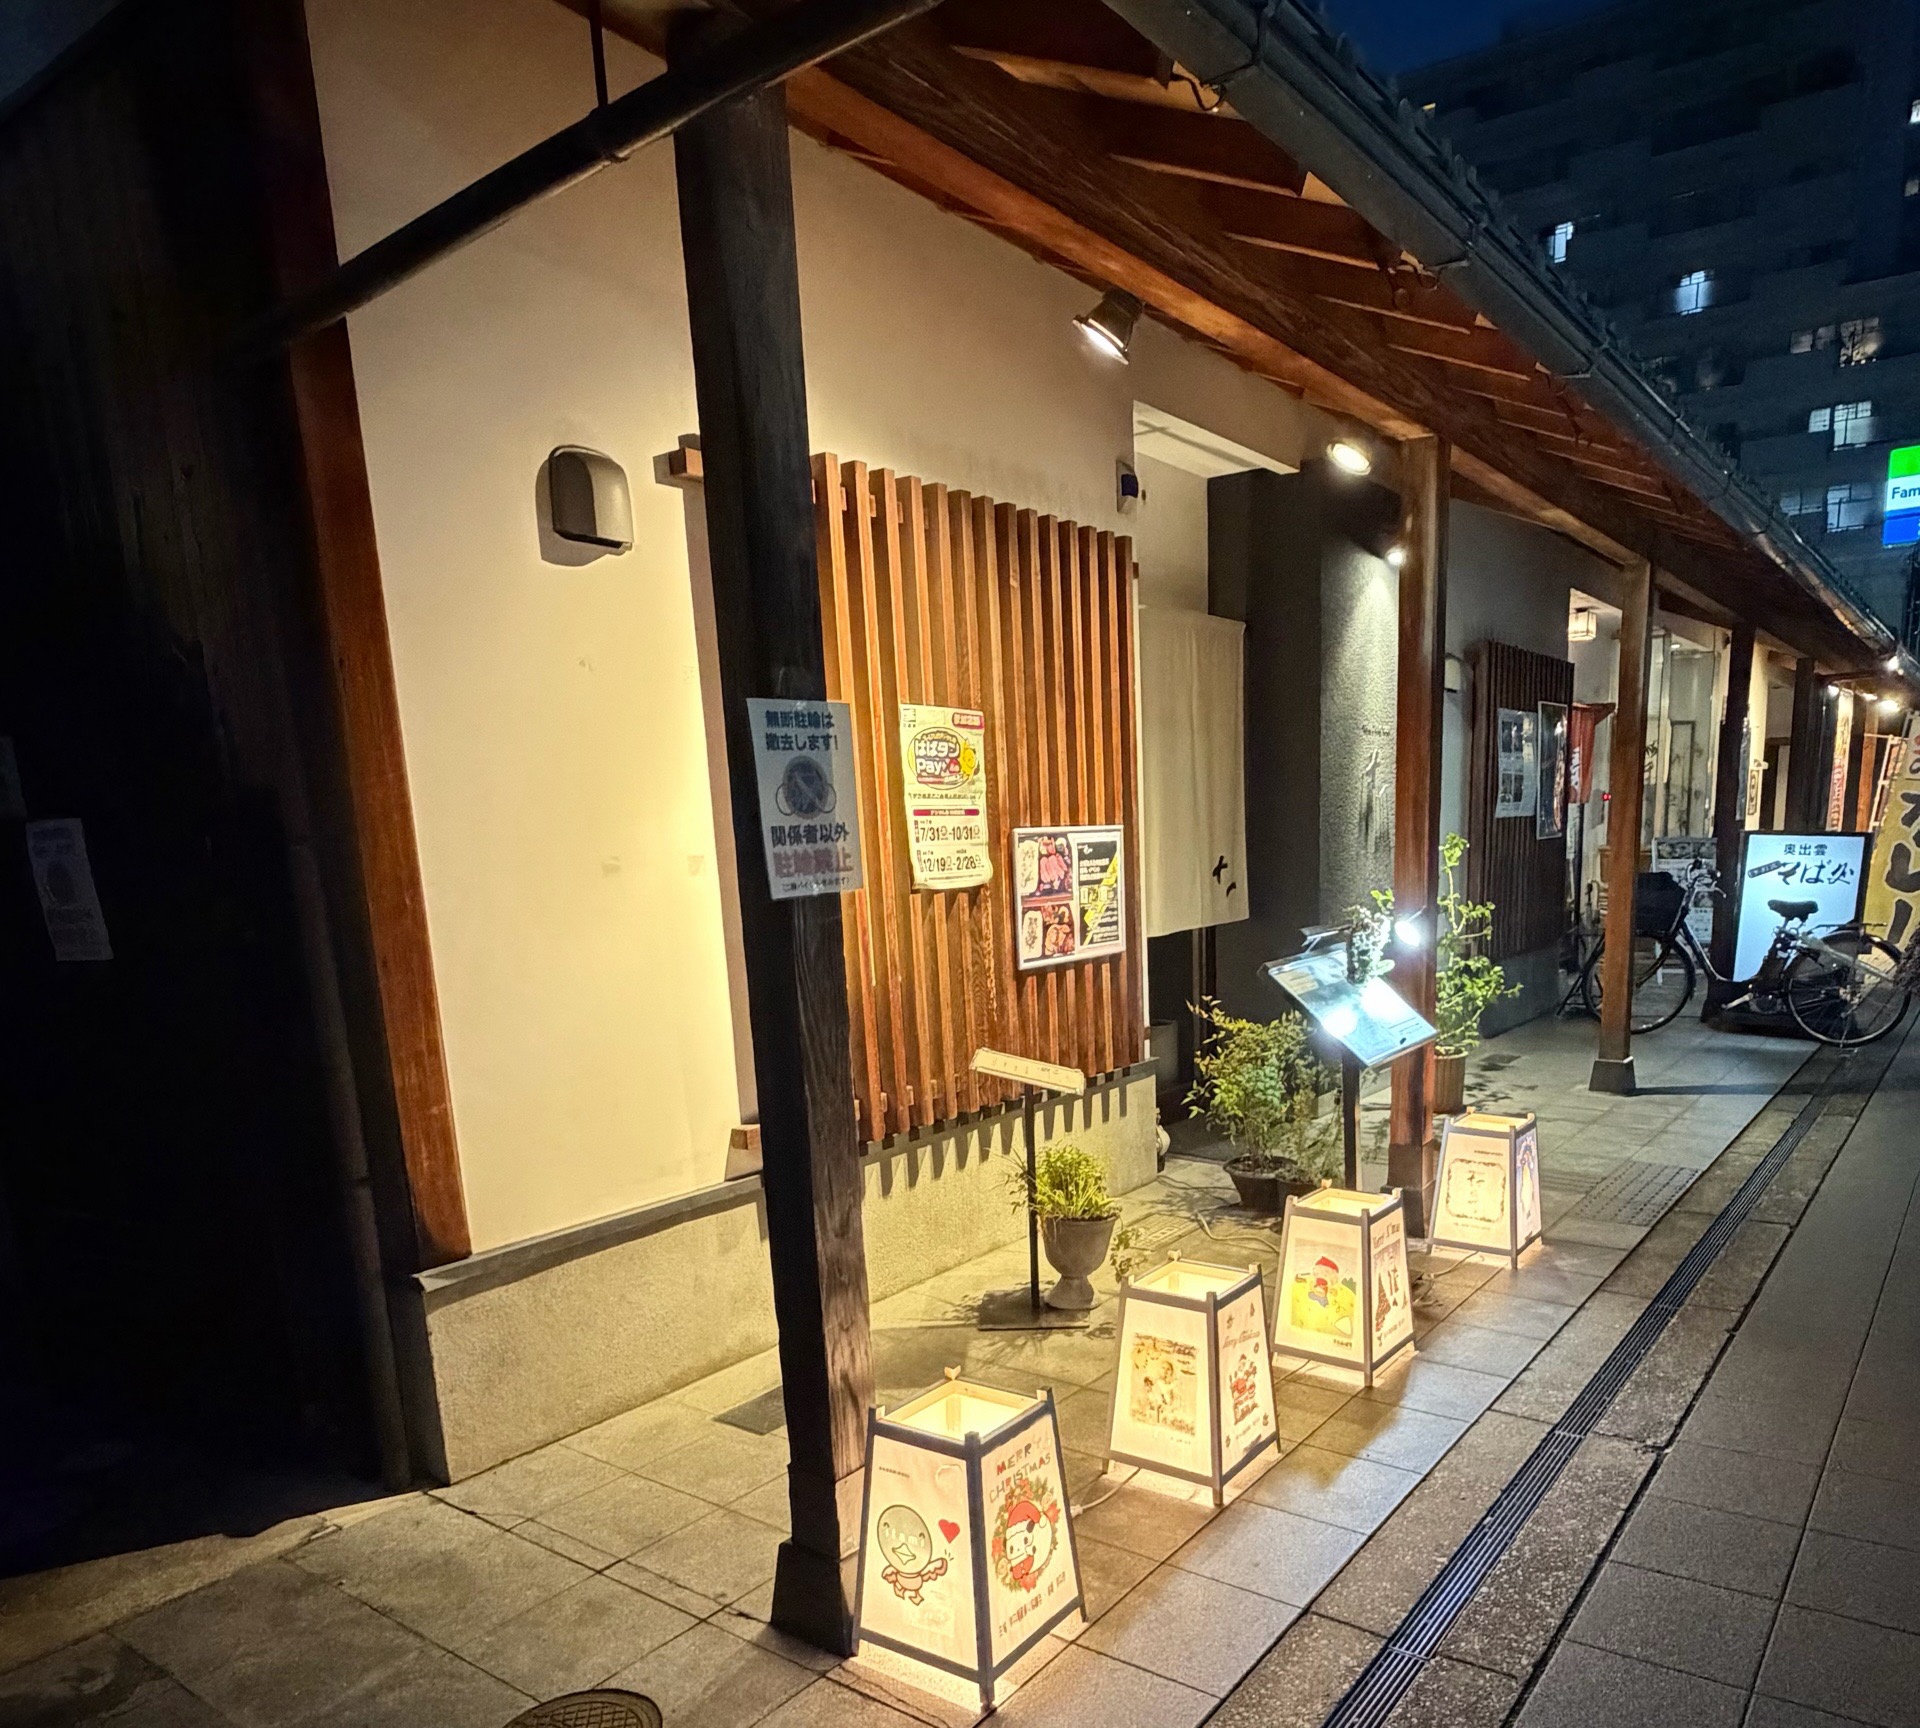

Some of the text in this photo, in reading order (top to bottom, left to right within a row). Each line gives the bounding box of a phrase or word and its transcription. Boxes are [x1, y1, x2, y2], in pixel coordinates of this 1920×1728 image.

[1891, 486, 1920, 499] Fam
[765, 710, 835, 729] 無断駐輪は
[770, 822, 850, 848] 関係者以外
[920, 826, 940, 842] 7/31
[1783, 843, 1828, 856] 奥出雲
[989, 1452, 1051, 1504] CHRISTMAS
